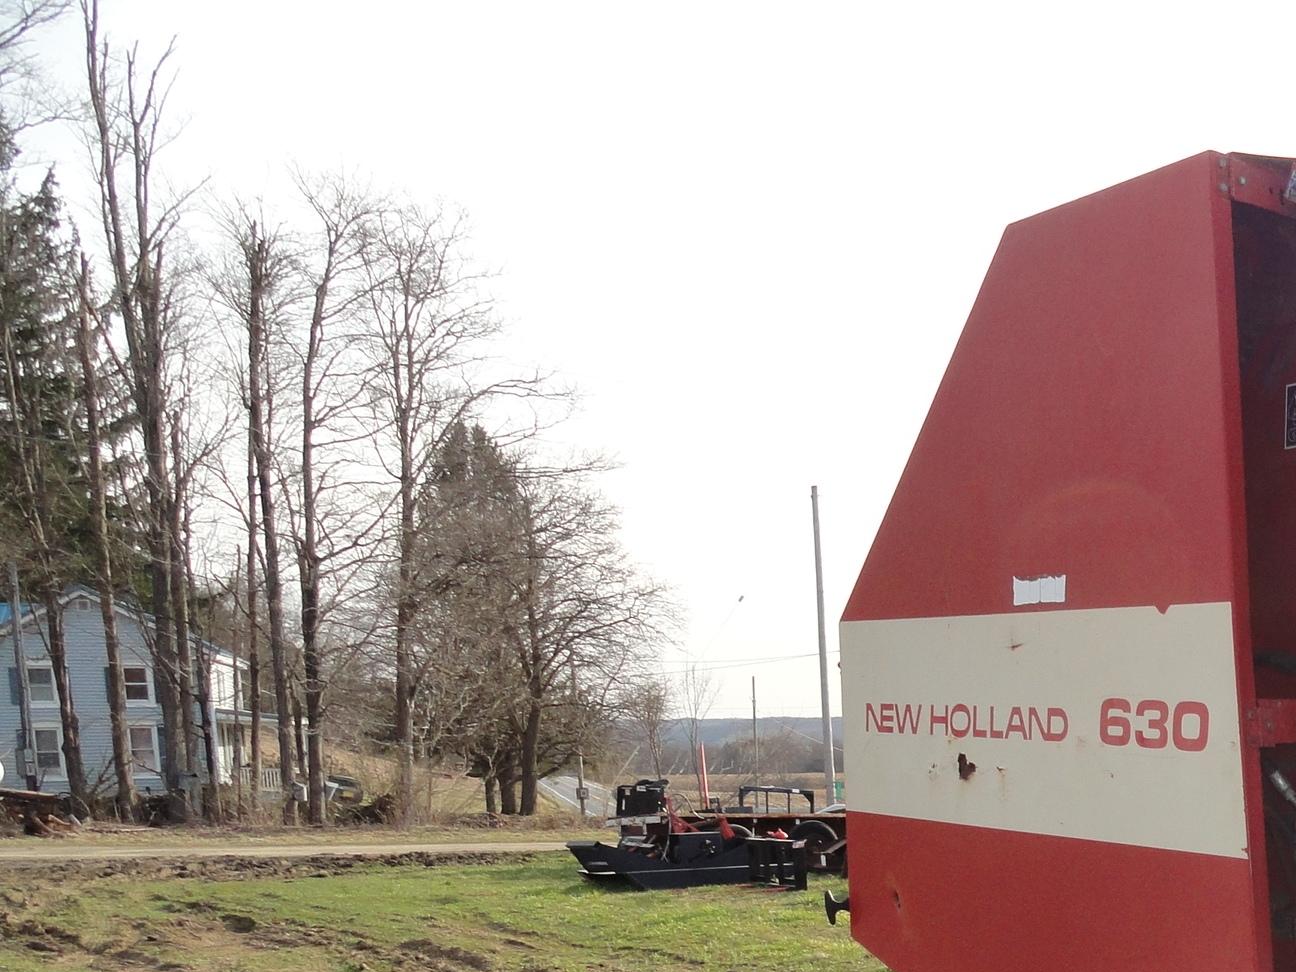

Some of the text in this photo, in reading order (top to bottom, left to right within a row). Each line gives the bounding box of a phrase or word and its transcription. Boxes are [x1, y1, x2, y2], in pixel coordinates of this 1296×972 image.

[865, 698, 1210, 752] NEW HOLLAND 630
